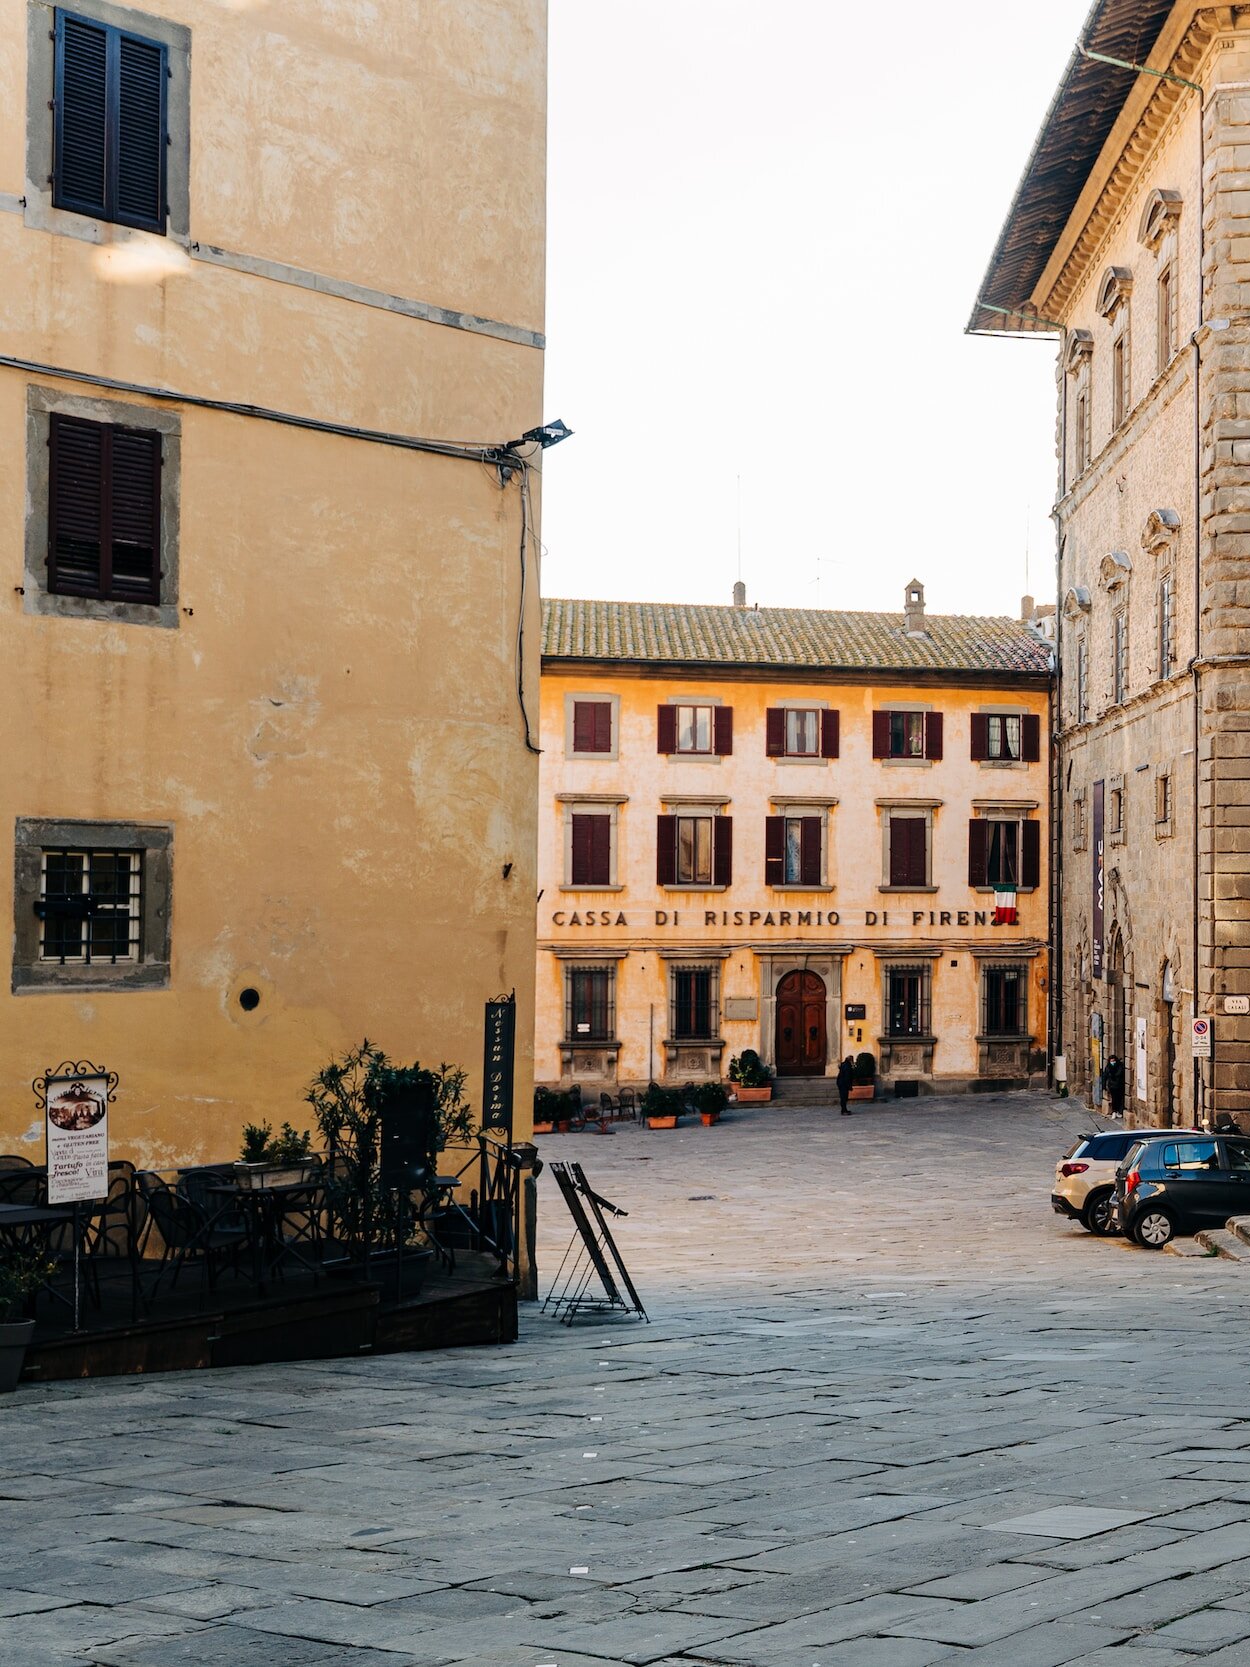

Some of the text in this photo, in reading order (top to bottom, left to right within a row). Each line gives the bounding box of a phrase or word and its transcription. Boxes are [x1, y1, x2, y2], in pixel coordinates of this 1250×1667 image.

[552, 911, 628, 926] CASSA
[655, 911, 679, 926] DI
[705, 911, 840, 926] RISPARMIO
[866, 911, 888, 926] DI
[490, 1008, 505, 1119] Nessun Dorma
[68, 1132, 105, 1141] VEGETARIANO
[63, 1141, 84, 1149] GLUTEN
[53, 1161, 83, 1170] Tartufo
[51, 1169, 80, 1179] fresco!
[85, 1167, 104, 1177] Vini
